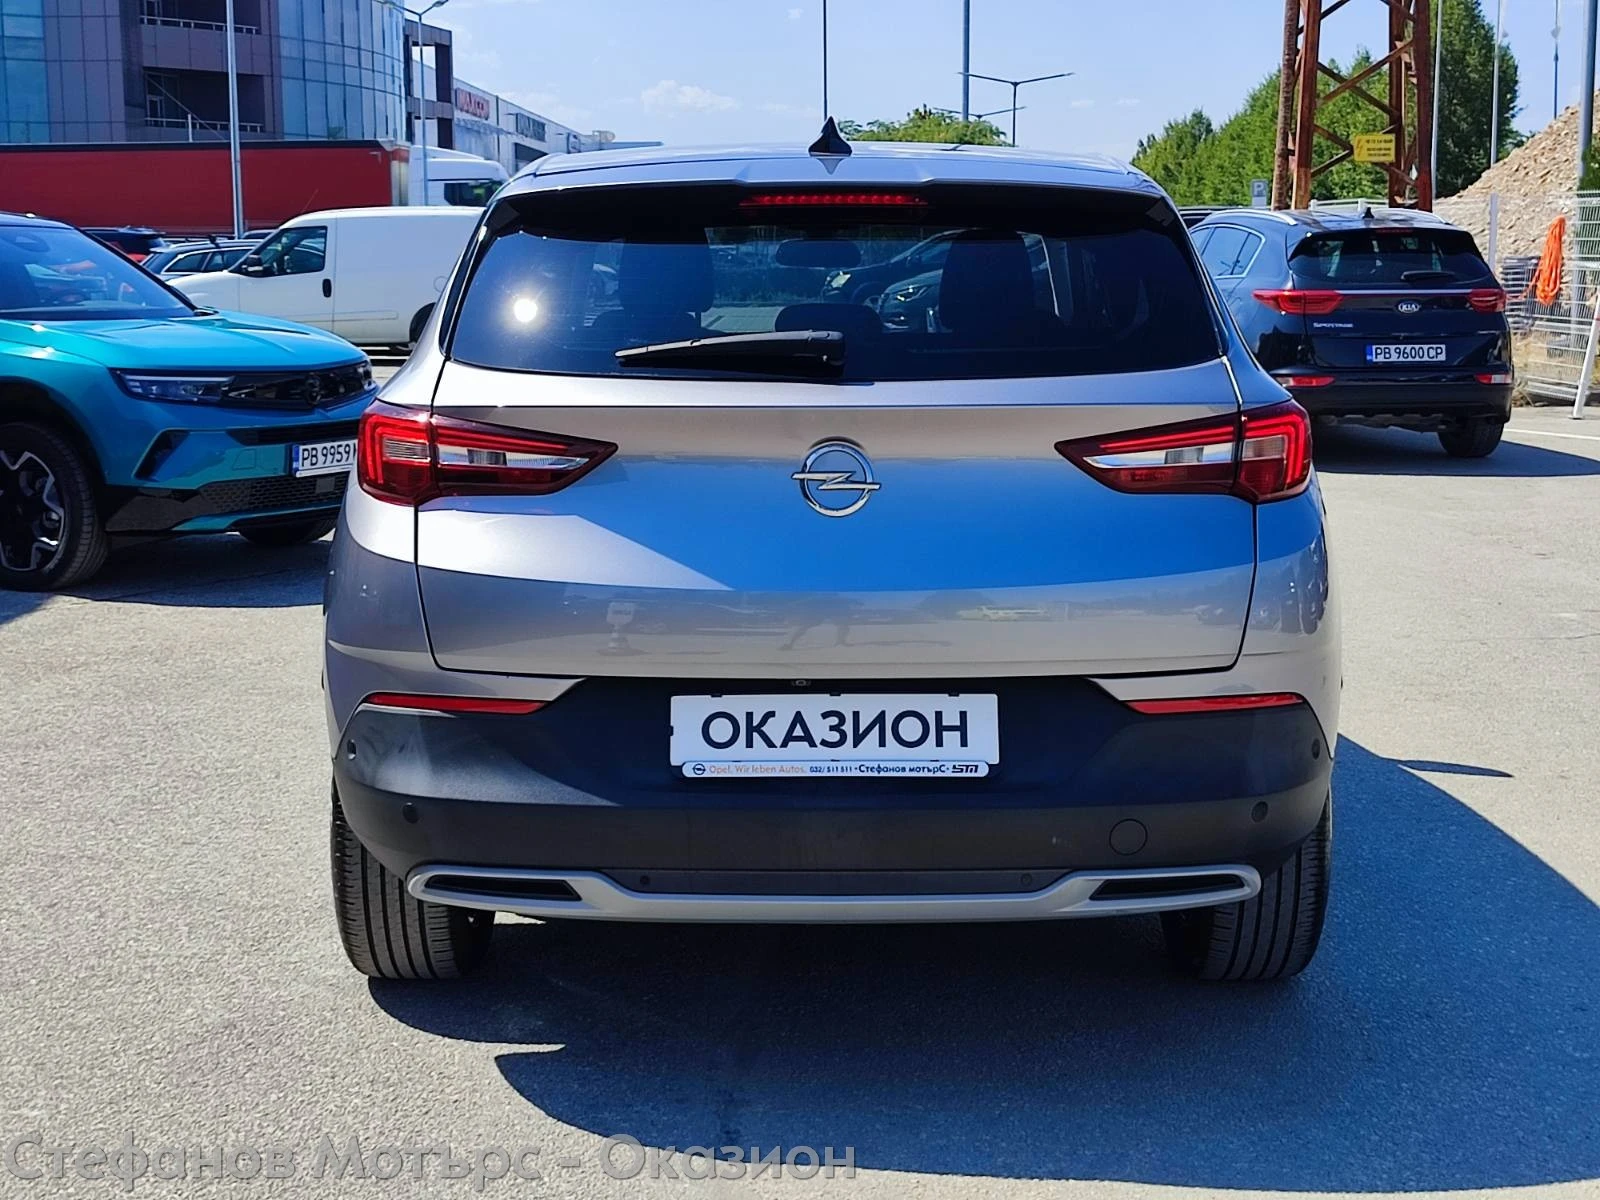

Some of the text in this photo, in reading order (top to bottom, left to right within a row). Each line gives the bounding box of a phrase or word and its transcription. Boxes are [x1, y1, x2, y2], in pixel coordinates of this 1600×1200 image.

[1254, 182, 1265, 196] P
[1401, 302, 1416, 311] KIA
[1374, 346, 1443, 359] PB 9600 CP
[302, 447, 318, 467] PB
[321, 443, 350, 466] 9959
[701, 710, 969, 749] ОКАЗИОН
